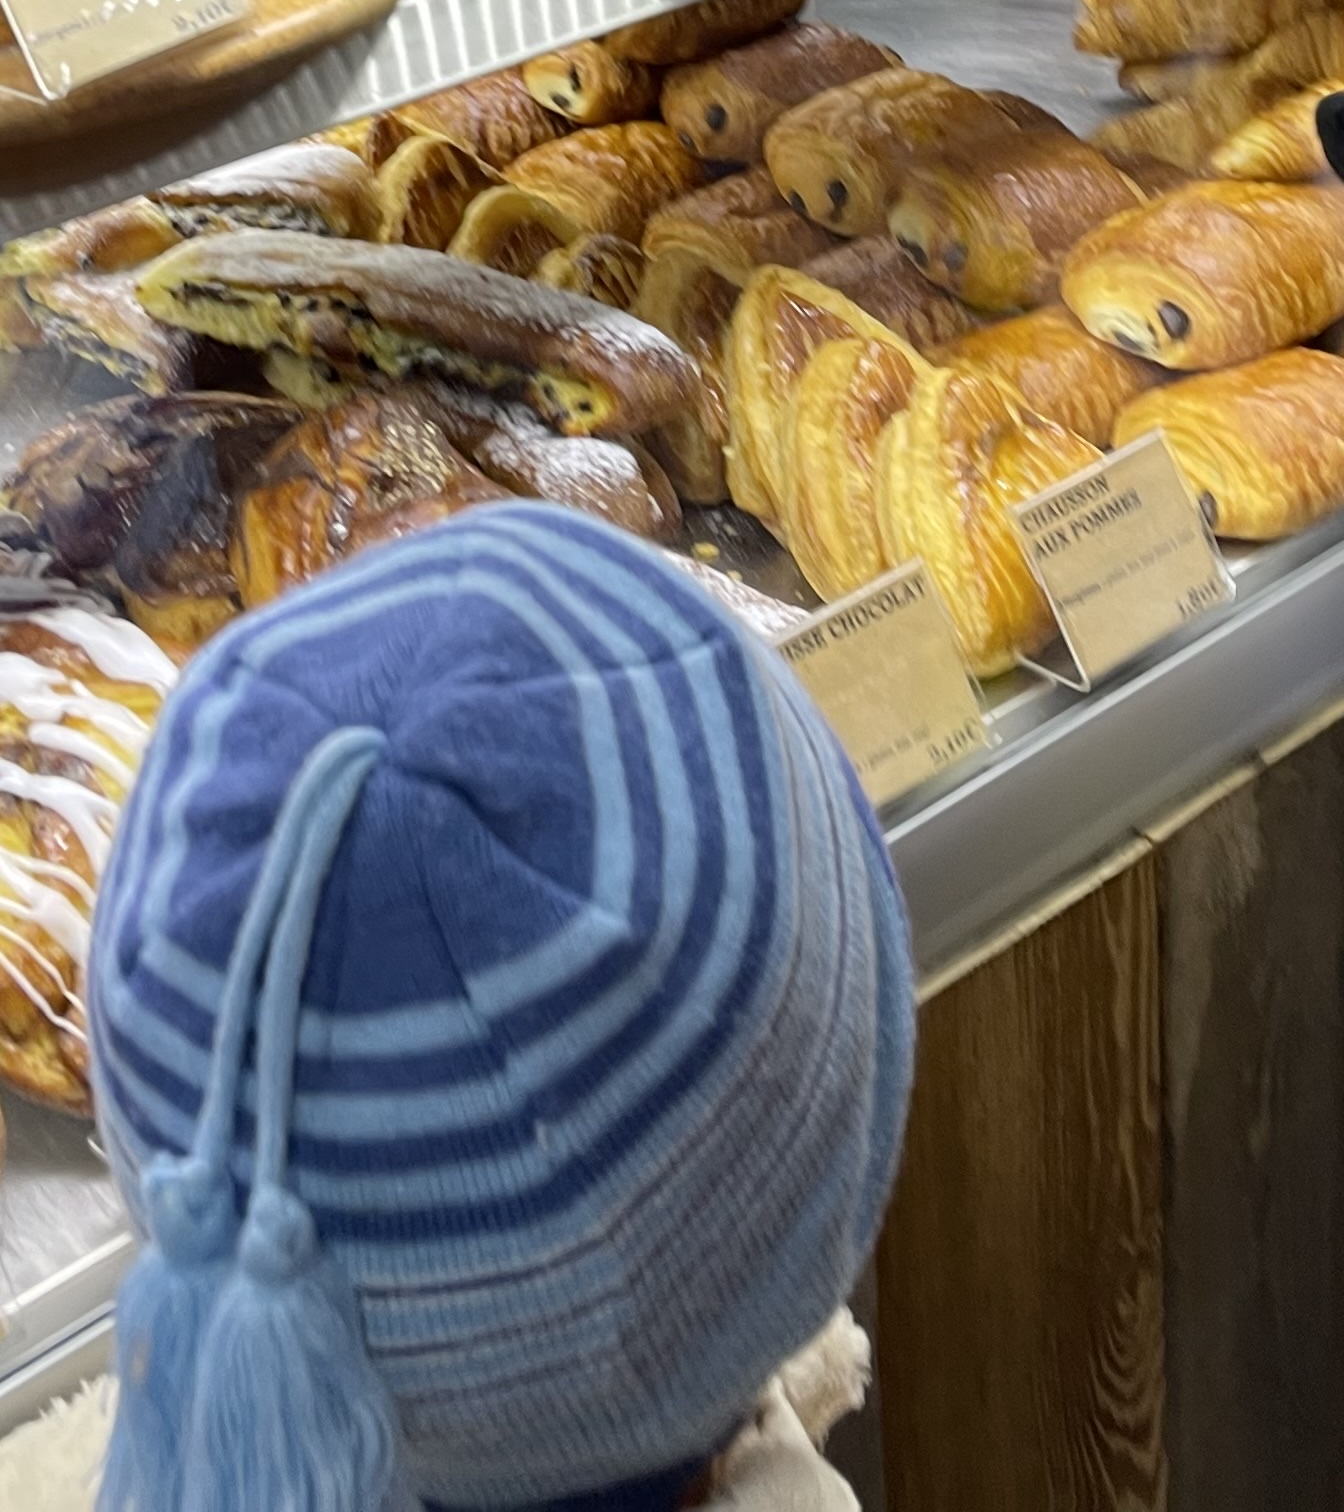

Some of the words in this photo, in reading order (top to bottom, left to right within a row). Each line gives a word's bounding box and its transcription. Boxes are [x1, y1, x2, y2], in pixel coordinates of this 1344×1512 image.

[1020, 474, 1111, 534] CHAUSSON
[1035, 529, 1073, 563] AUX
[1069, 487, 1143, 540] POMMES
[778, 629, 829, 662] ISSE
[827, 573, 928, 641] CHOCOLAT
